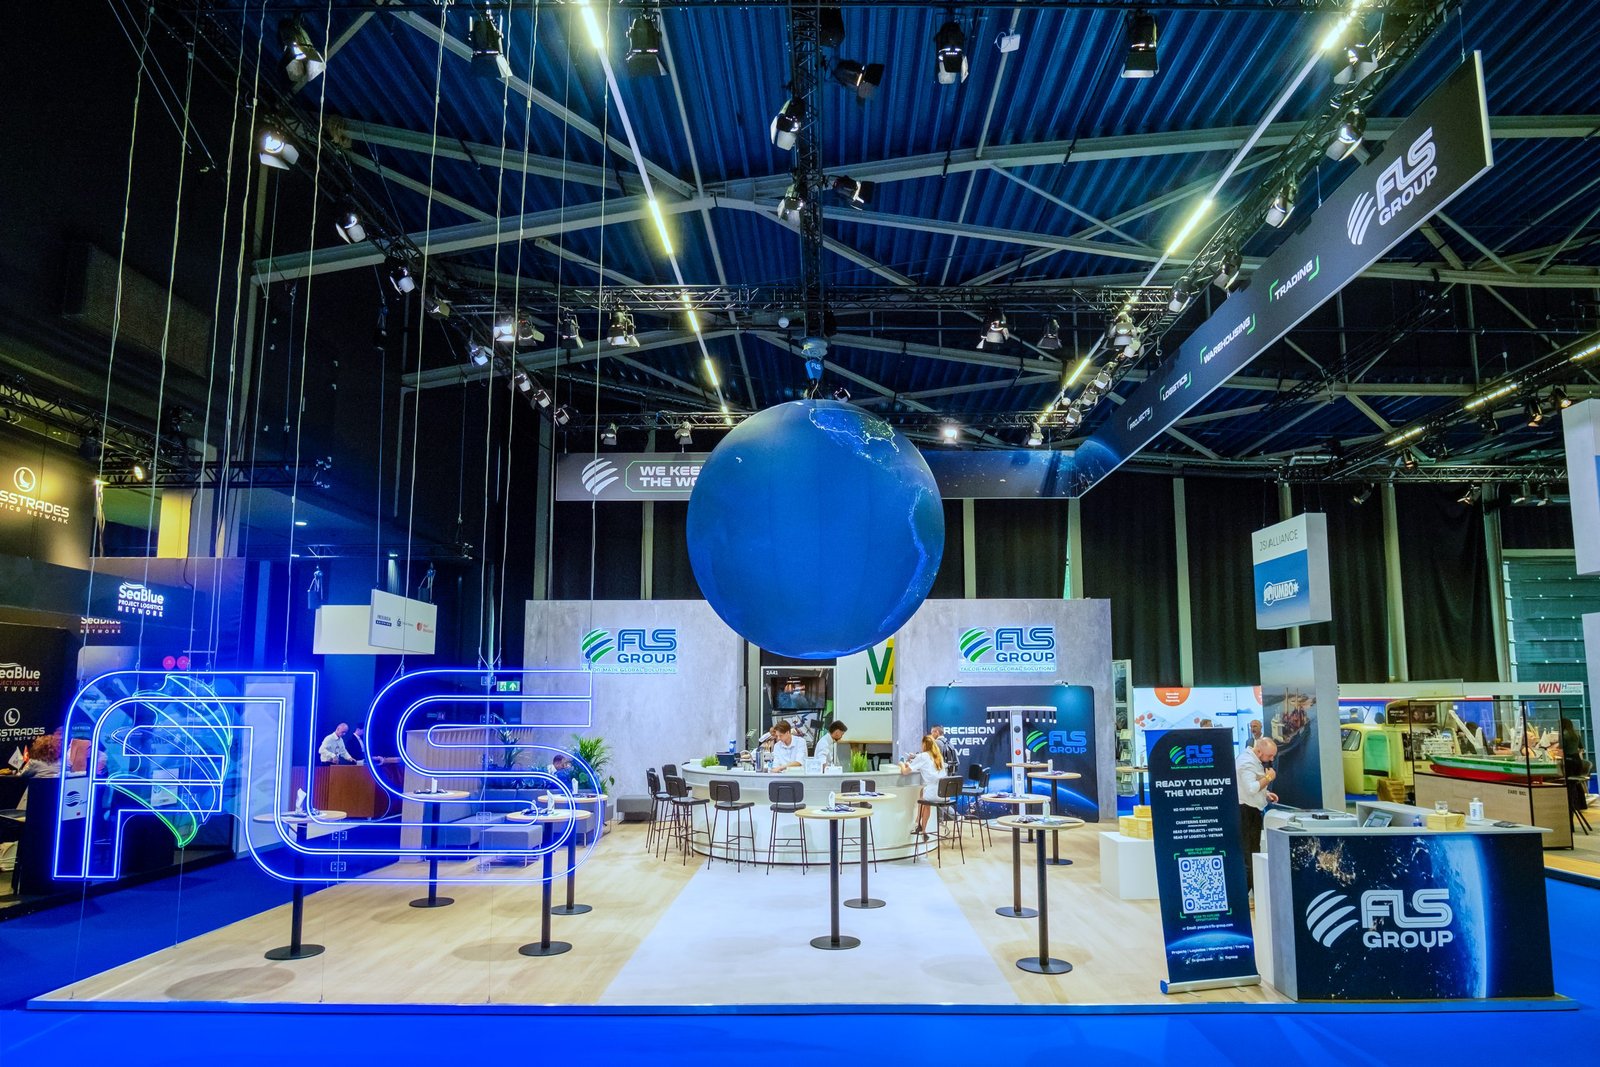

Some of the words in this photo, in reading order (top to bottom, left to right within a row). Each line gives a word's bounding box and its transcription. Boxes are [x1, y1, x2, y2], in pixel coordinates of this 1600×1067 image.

[1376, 126, 1436, 211] FLS
[1379, 165, 1437, 226] GROUP
[1275, 259, 1313, 300] TRADING
[1203, 316, 1251, 364] WAREHOUSING
[1162, 373, 1188, 400] LOGISTICS
[1129, 407, 1151, 431] PROJECTS
[640, 466, 665, 476] WE
[670, 466, 702, 476] KEE
[640, 477, 671, 487] THE
[26, 509, 69, 524] NETWORK
[1268, 529, 1298, 548] ALLIANCE
[119, 585, 164, 604] SeaBlue
[118, 599, 139, 608] PROJECT
[140, 602, 163, 611] LOGISTICS
[118, 606, 163, 617] NETWORK
[617, 628, 677, 652] FLS
[995, 627, 1055, 651] FLS
[617, 653, 677, 664] GROUP
[995, 652, 1055, 663] GROUP
[1538, 683, 1561, 694] WIN
[0, 727, 45, 737] STRADES
[943, 726, 996, 735] RECISION
[950, 737, 988, 746] EVERY
[1049, 731, 1087, 746] FLS
[955, 748, 970, 756] VE
[1049, 746, 1087, 754] GROUP
[1185, 744, 1213, 758] FLS
[53, 669, 602, 882] FLS
[1155, 780, 1187, 788] READY
[1203, 778, 1231, 786] MOVE
[1185, 788, 1224, 797] WORLD?
[1360, 888, 1453, 928] FLS
[1362, 930, 1454, 948] GROUP
